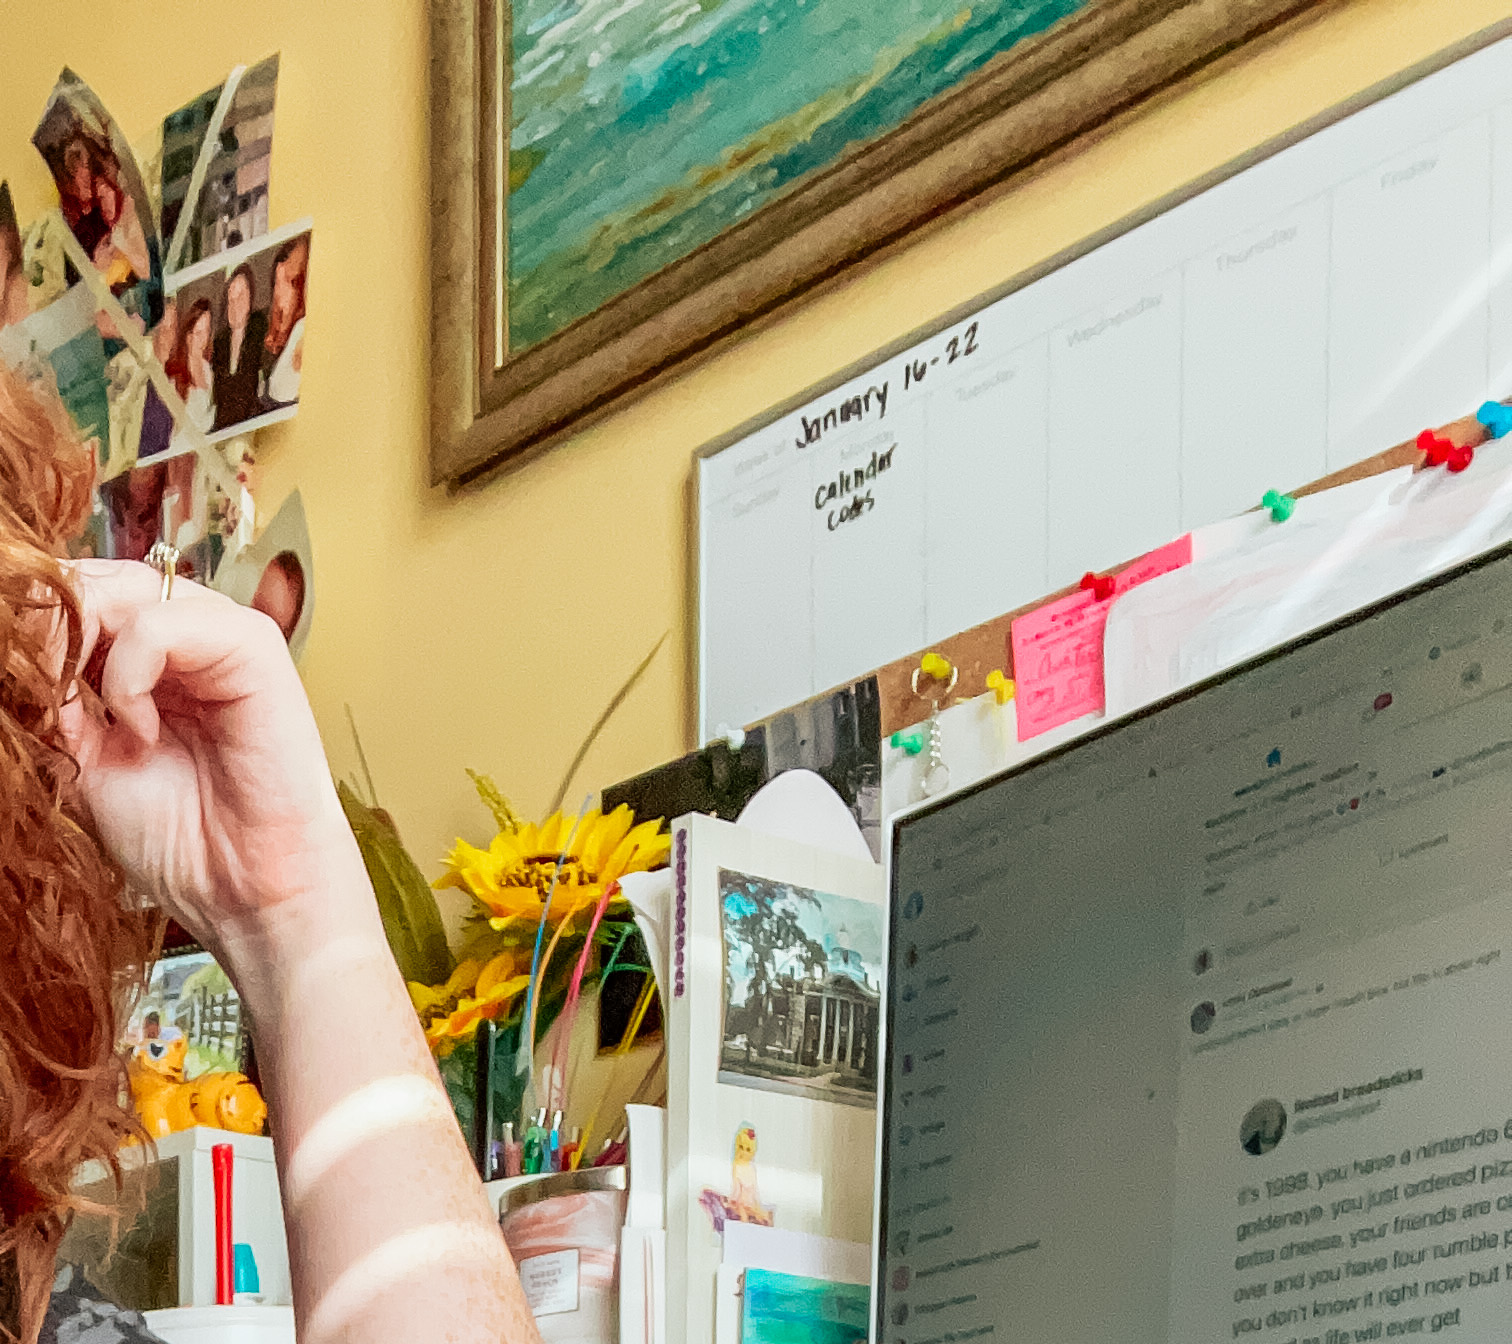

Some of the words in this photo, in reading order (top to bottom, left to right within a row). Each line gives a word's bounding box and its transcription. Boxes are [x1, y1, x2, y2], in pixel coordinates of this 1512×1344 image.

[1216, 225, 1298, 271] Thursday
[1067, 294, 1163, 347] Wednesday
[796, 381, 888, 448] January
[1316, 1168, 1348, 1191] you
[1354, 1154, 1395, 1176] have
[1416, 1128, 1498, 1160] nintendo
[1331, 1195, 1363, 1220] you
[1367, 1185, 1399, 1215] just
[1404, 1165, 1476, 1199] ordered
[1349, 1223, 1388, 1249] your
[1393, 1205, 1456, 1234] friends
[1462, 1200, 1491, 1220] are
[1234, 1283, 1267, 1304] over
[1274, 1271, 1305, 1294] and
[1309, 1266, 1340, 1290] you
[1345, 1256, 1388, 1278] have
[1393, 1247, 1426, 1269] four
[1433, 1231, 1499, 1260] rumble
[1232, 1317, 1262, 1339] you
[1266, 1304, 1307, 1328] don't
[1313, 1297, 1359, 1318] know
[1364, 1291, 1373, 1309] it
[1378, 1281, 1419, 1307] right
[1425, 1274, 1465, 1296] now
[1469, 1266, 1499, 1288] but
[1354, 1320, 1382, 1343] will
[1386, 1317, 1425, 1337] ever
[1430, 1307, 1461, 1333] get
